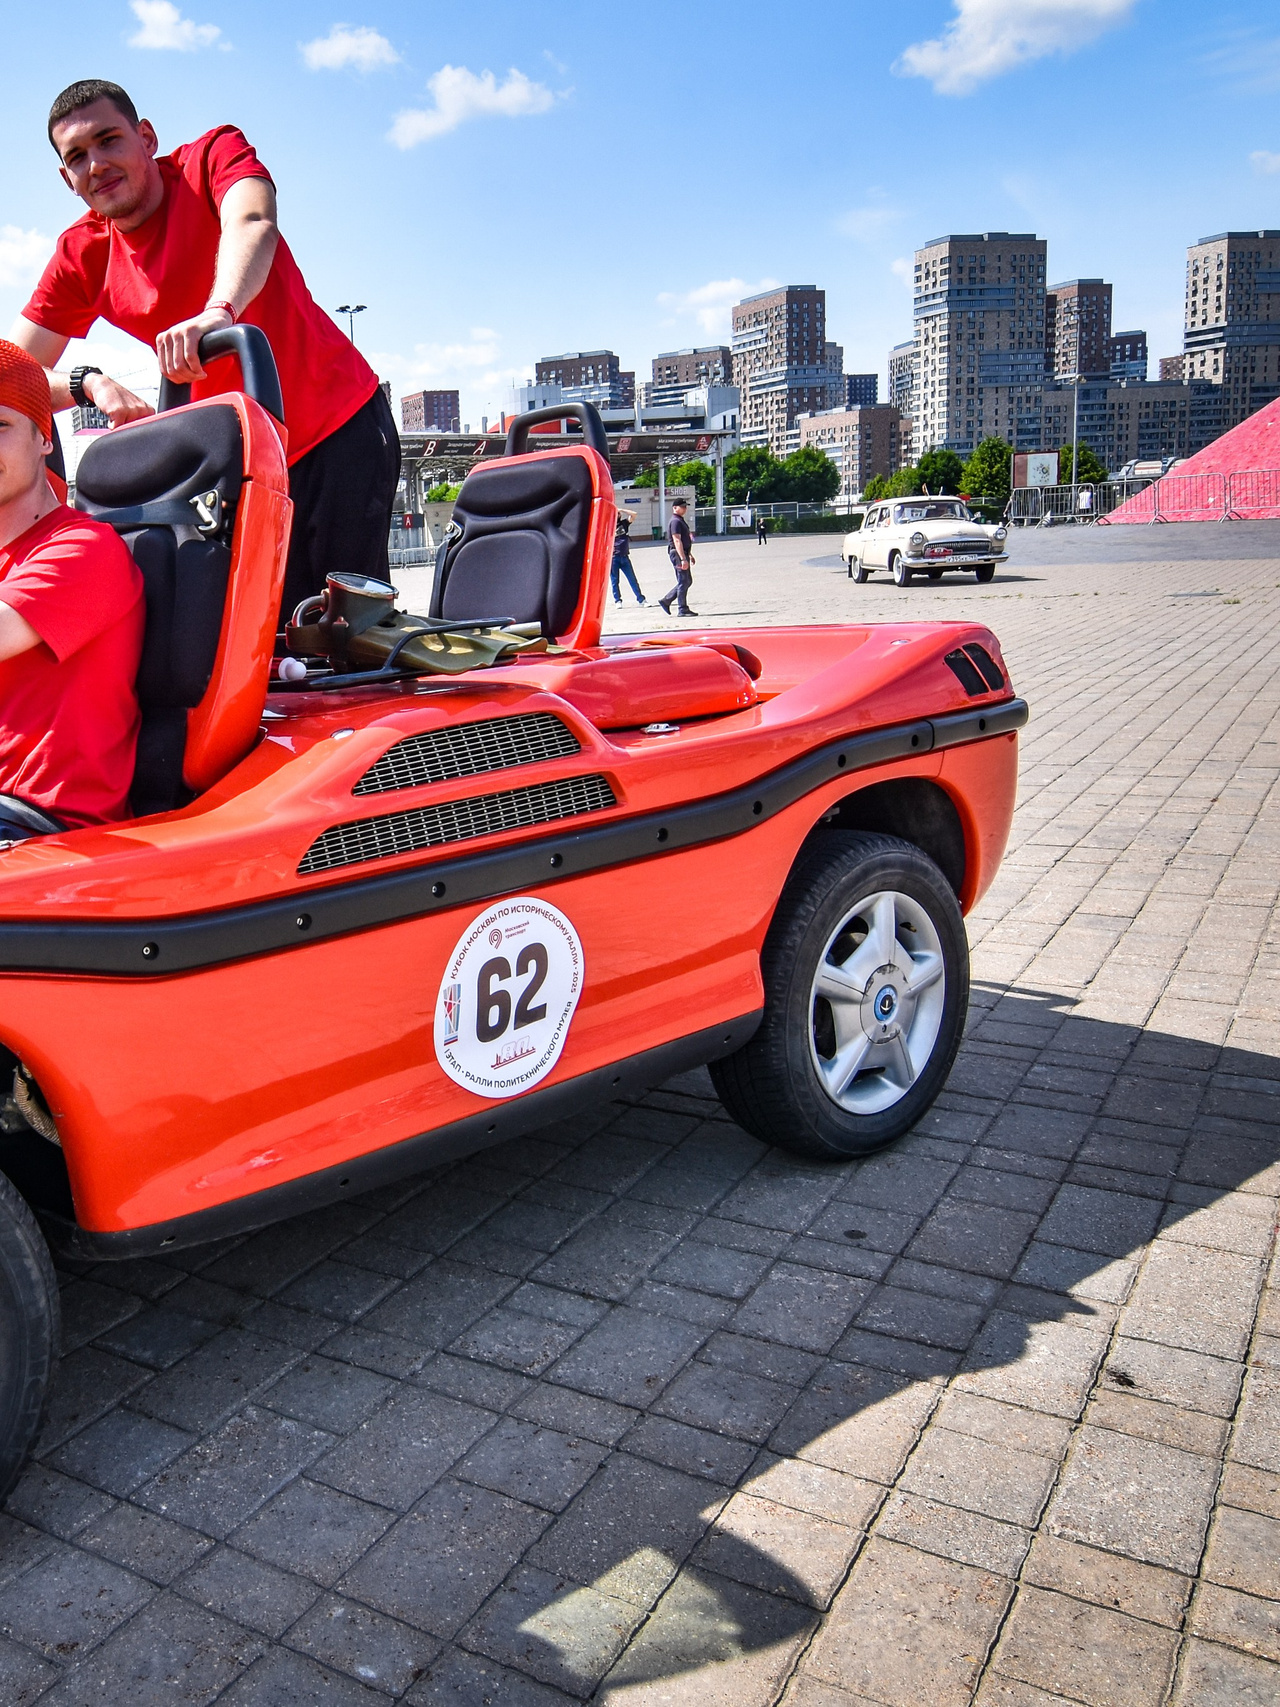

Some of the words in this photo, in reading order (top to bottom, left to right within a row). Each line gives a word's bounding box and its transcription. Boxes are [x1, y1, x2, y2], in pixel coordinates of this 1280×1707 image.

[670, 488, 688, 496] SHOP
[450, 945, 469, 979] КУБОК
[466, 913, 498, 947] МОСКВЫ
[497, 907, 510, 918] ПО
[510, 904, 569, 936] ИСТОРИЧЕСКОМУ
[565, 935, 578, 965] РАЛЛИ
[476, 942, 549, 1043] 62
[445, 1051, 462, 1072] ЭТАП
[465, 1070, 493, 1088] РАЛЛИ
[494, 1032, 560, 1089] ПОЛИТЕХНИЧЕСКОГО
[556, 1001, 573, 1031] МУЗЕЯ
